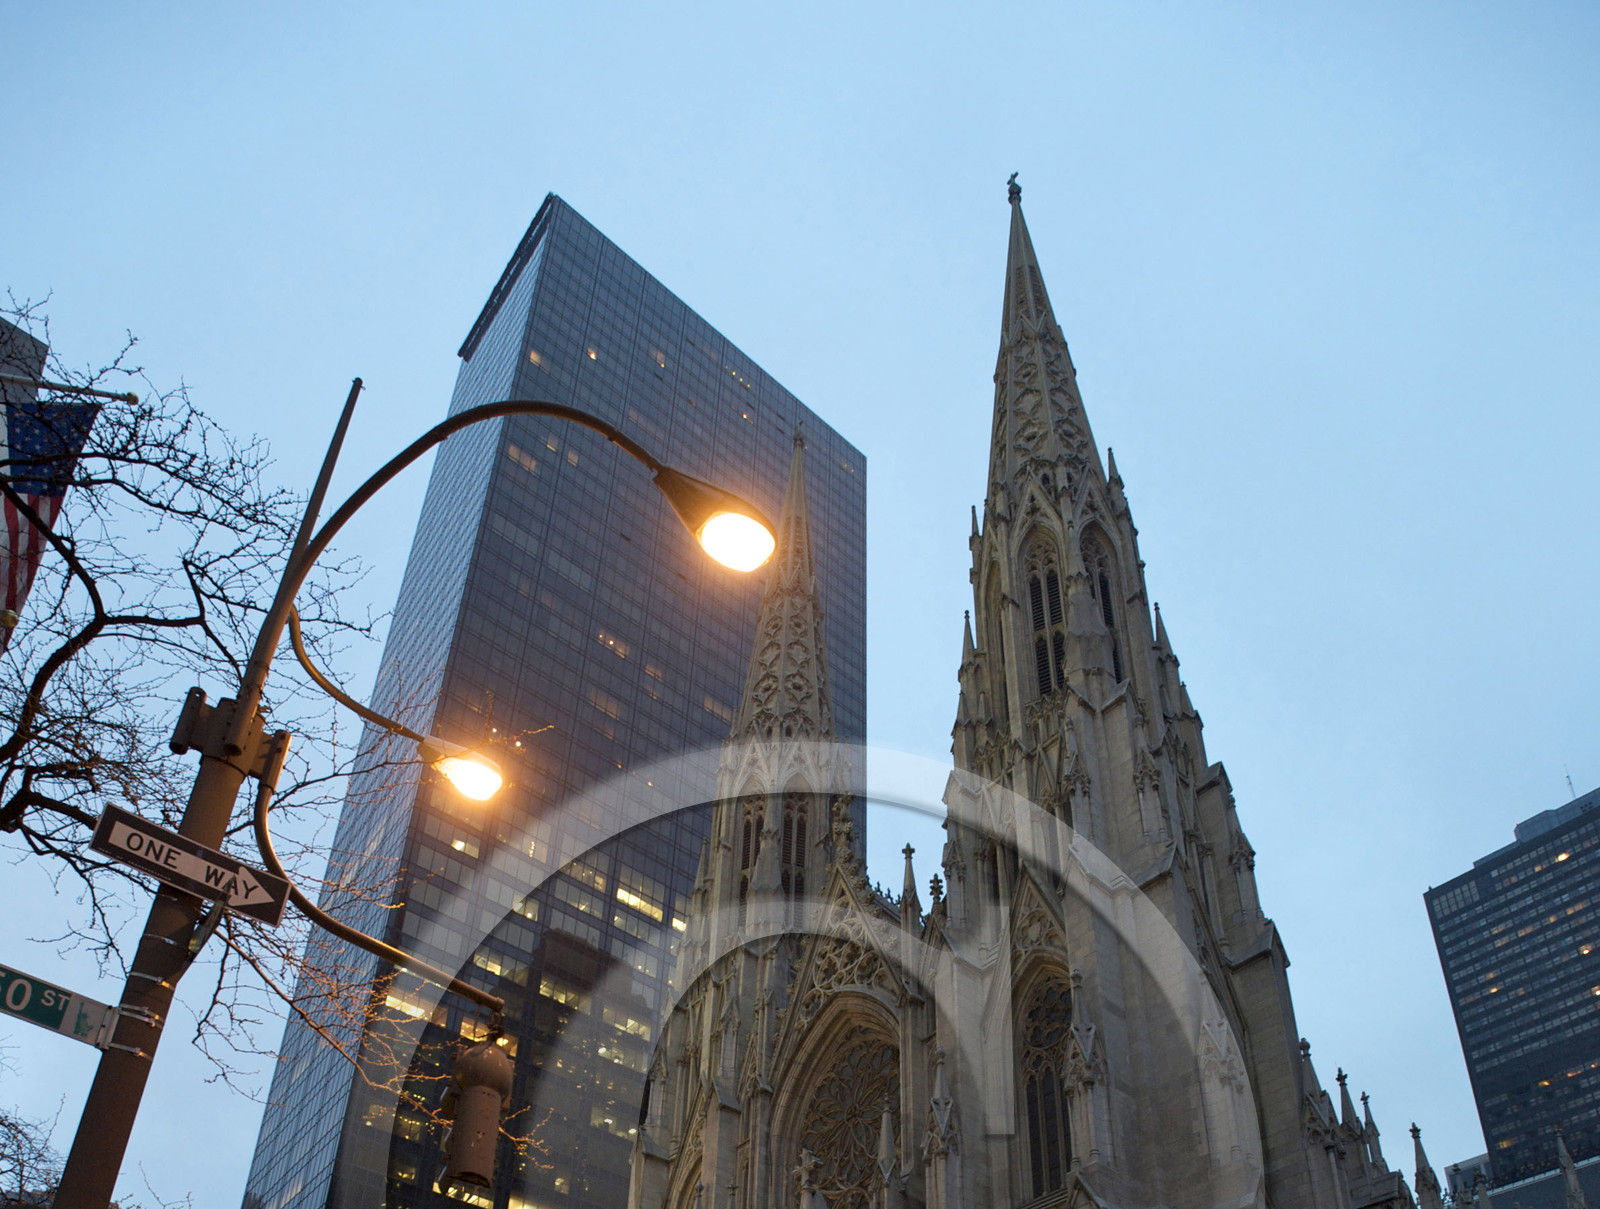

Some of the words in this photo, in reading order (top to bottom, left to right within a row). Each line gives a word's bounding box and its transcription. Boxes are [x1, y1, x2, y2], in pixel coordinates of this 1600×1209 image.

[126, 832, 182, 869] ONE
[205, 865, 259, 899] WAY
[41, 989, 70, 1011] ST
